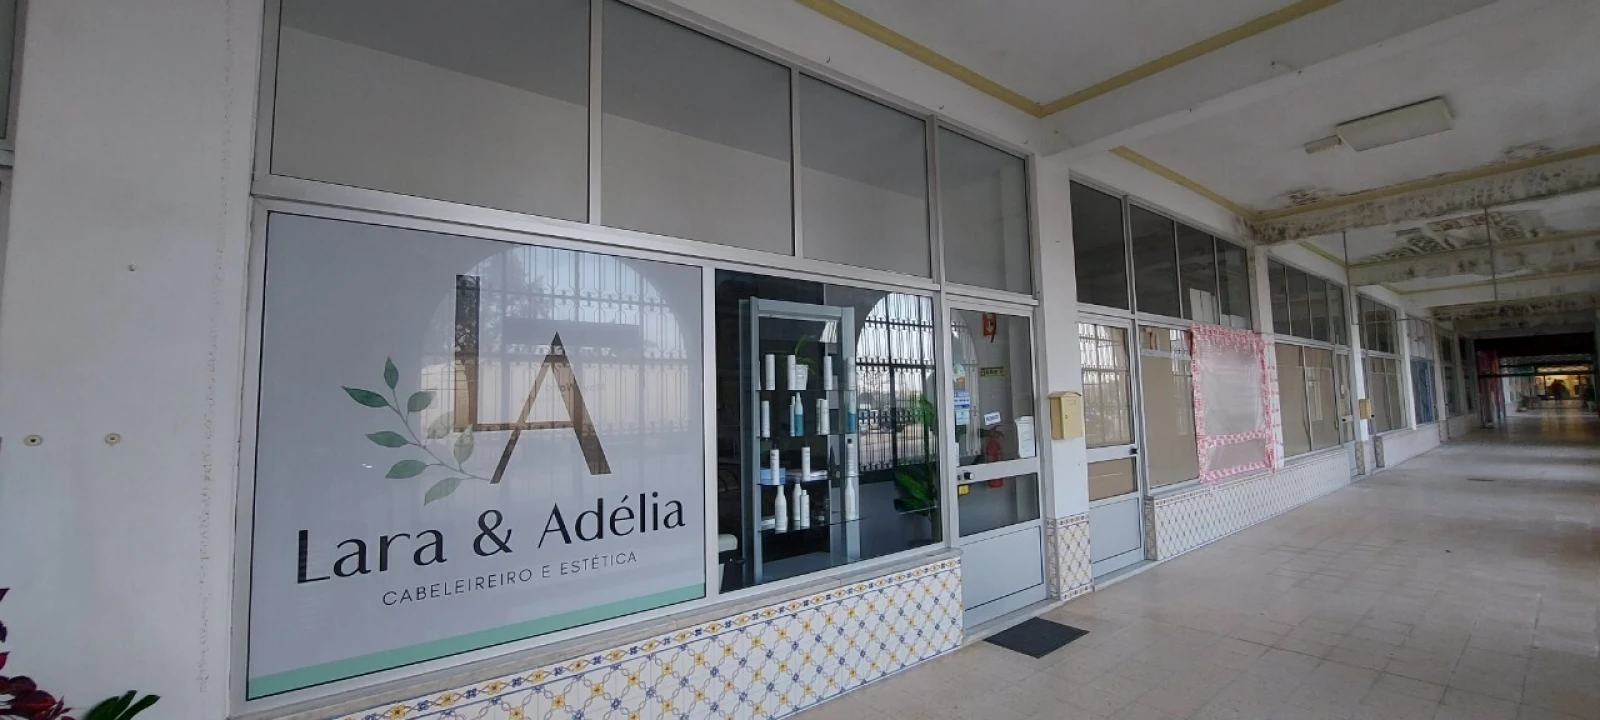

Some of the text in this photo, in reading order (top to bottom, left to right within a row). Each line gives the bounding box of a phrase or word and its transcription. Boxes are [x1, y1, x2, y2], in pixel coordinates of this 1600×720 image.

[296, 491, 686, 585] Lara & Adélia
[382, 552, 637, 606] CABELEIREIRO E ESTÉTICA
